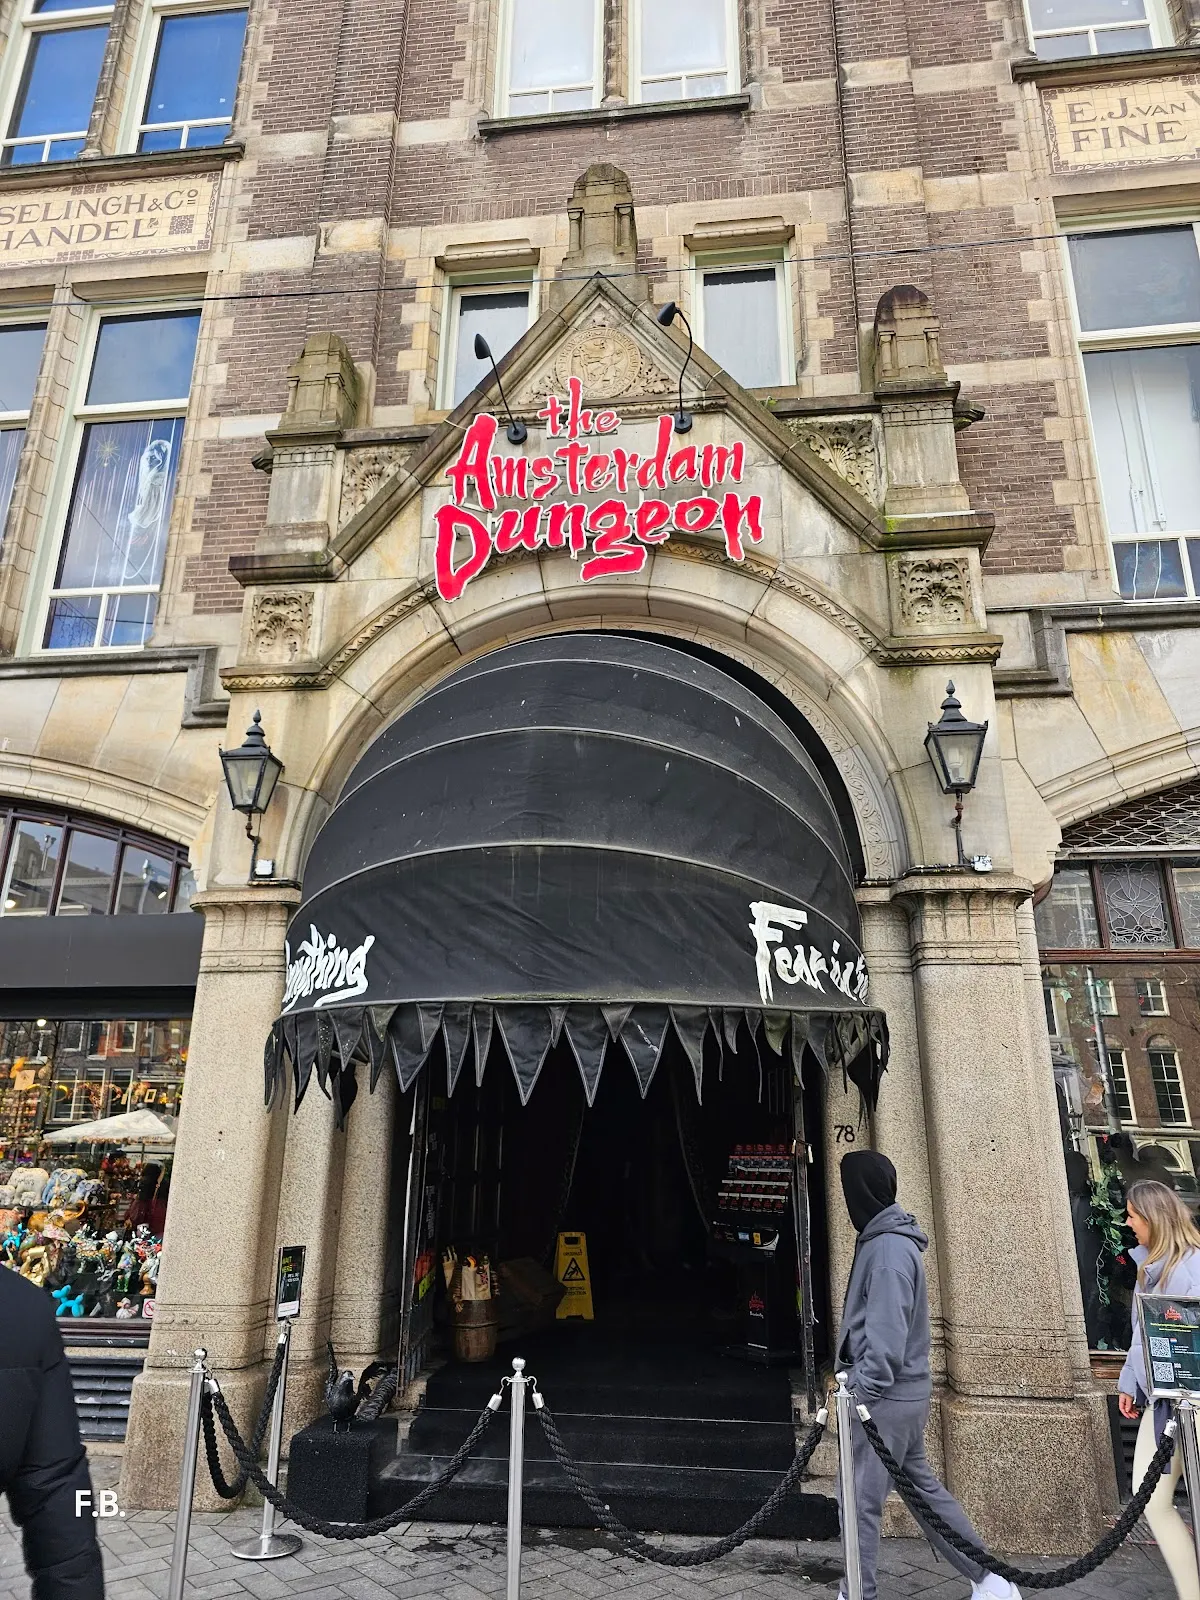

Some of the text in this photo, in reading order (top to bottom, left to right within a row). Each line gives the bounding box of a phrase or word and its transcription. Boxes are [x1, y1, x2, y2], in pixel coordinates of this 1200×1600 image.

[1071, 120, 1188, 153] FINE
[537, 376, 622, 440] the
[445, 412, 746, 511] Amsterdam
[433, 491, 764, 602] Dungeon
[833, 1124, 855, 1143] 78
